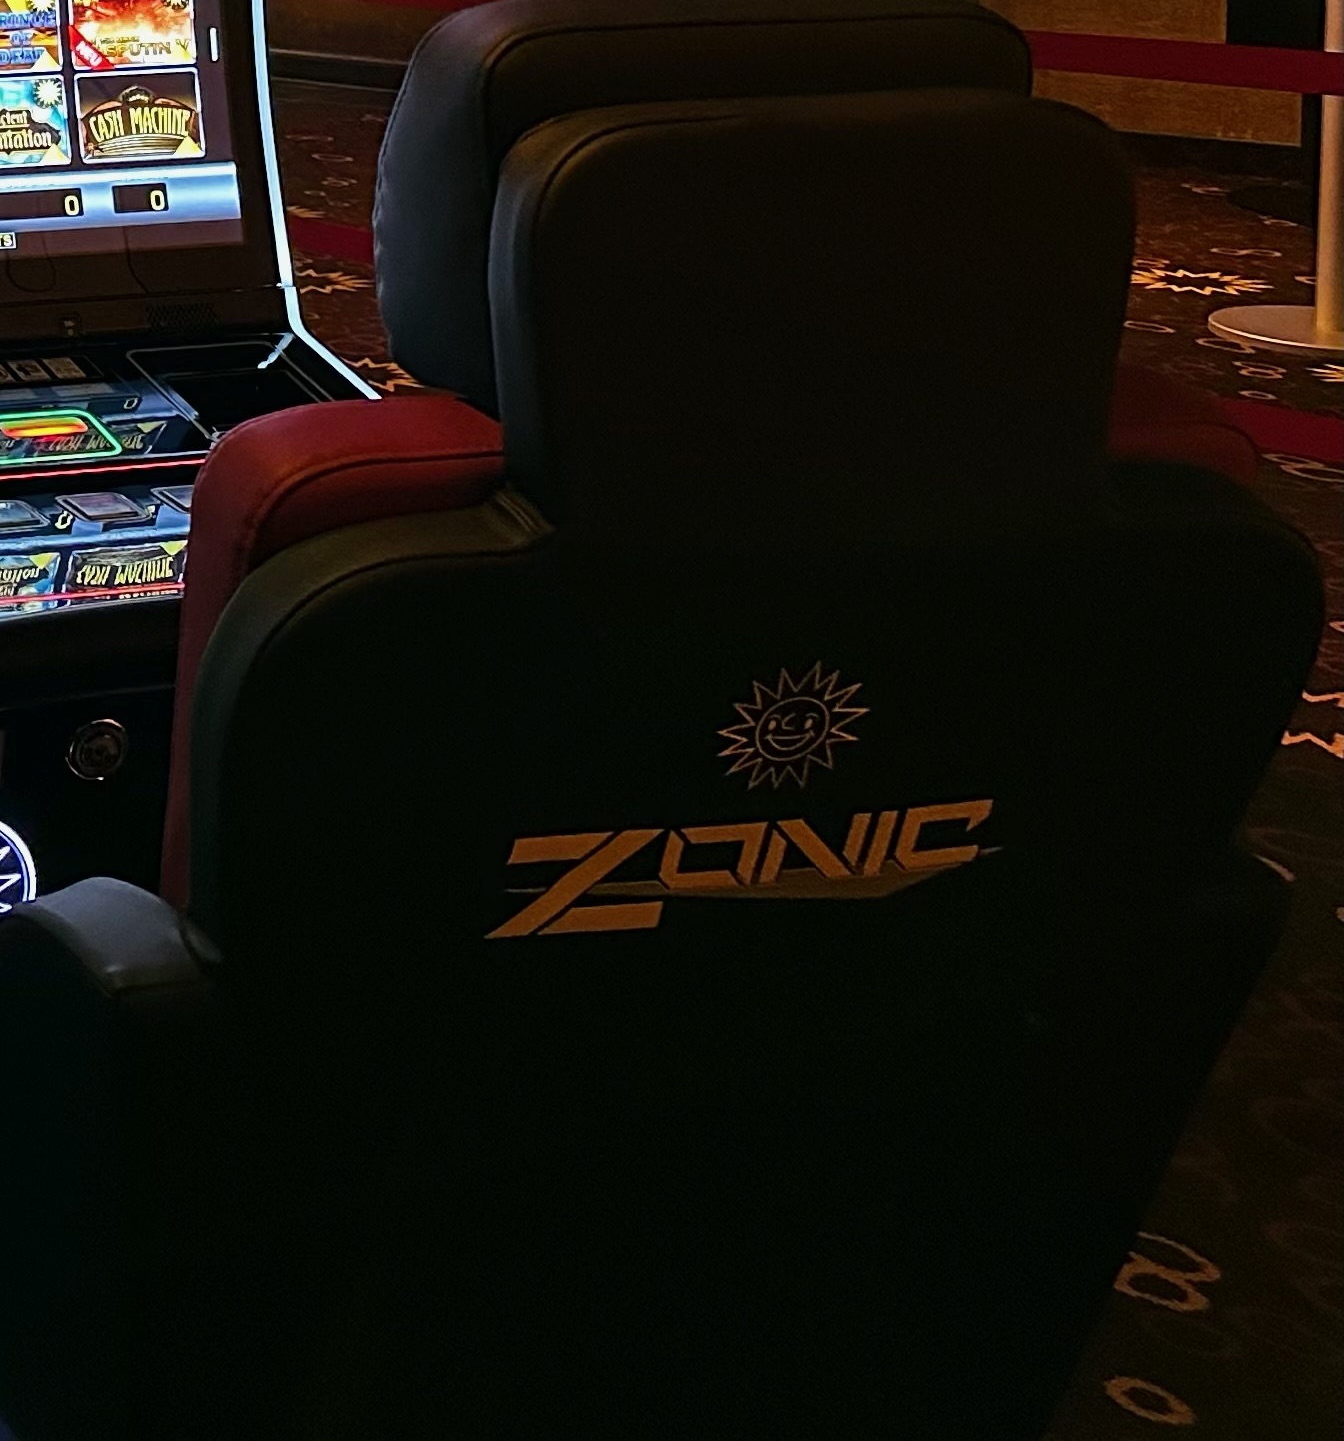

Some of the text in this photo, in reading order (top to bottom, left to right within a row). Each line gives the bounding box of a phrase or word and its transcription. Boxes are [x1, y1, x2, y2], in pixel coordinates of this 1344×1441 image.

[89, 107, 192, 143] CASH MACHINE
[64, 195, 79, 216] 0
[150, 190, 165, 211] 0
[483, 799, 995, 940] ZONIC
